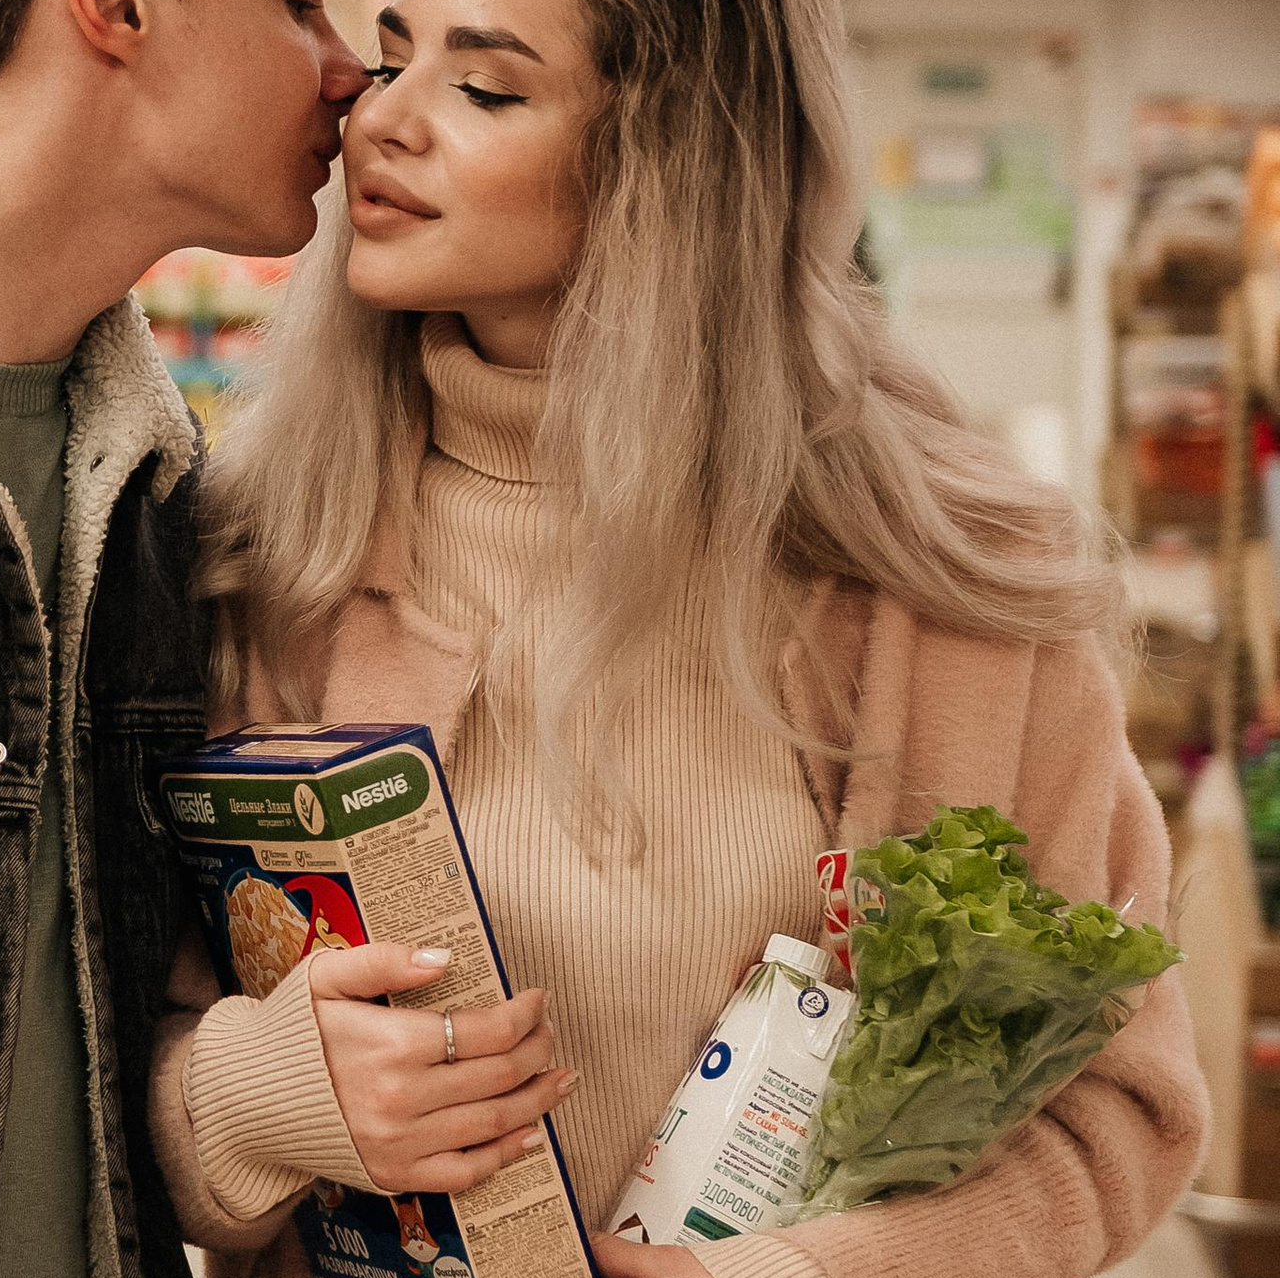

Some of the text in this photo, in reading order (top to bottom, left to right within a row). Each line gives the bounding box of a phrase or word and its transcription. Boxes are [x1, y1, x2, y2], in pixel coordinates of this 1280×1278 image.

[229, 798, 293, 816] Цельные Злаки
[363, 895, 390, 909] МАССА
[418, 875, 435, 890] 325
[742, 1108, 756, 1121] НЕТ
[770, 1110, 781, 1122] NO
[732, 1128, 783, 1161] ТРОПИЧЕСКОГО
[700, 1178, 764, 1226] ЗДОРОВО!
[435, 1266, 469, 1278] Фоксфорд
